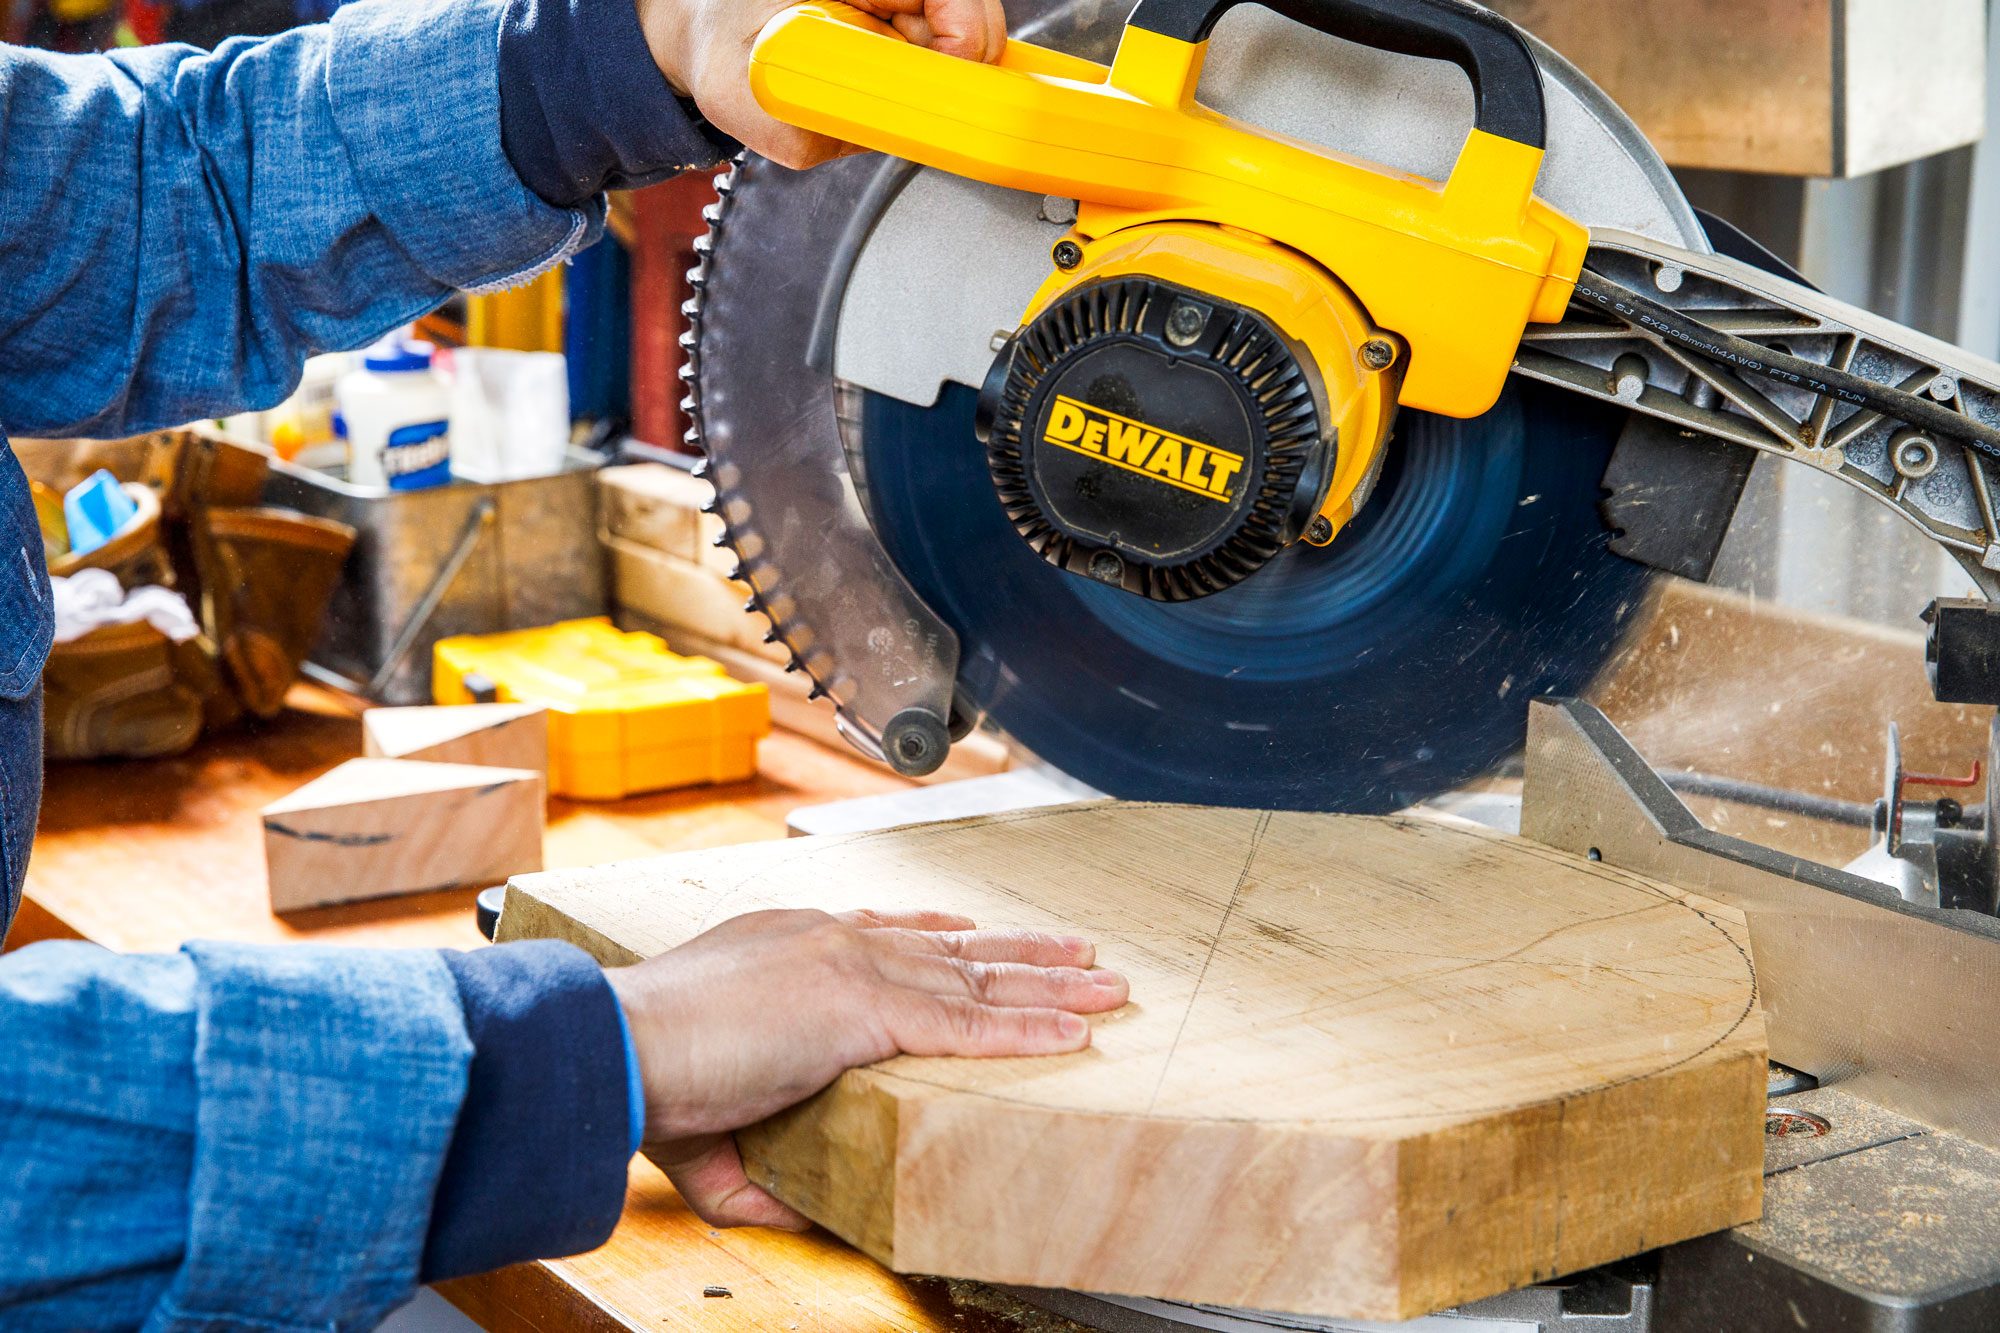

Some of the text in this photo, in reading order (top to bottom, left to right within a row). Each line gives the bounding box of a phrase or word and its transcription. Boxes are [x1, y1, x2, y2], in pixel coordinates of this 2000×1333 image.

[1615, 303, 1635, 315] SJ
[1769, 368, 1801, 382] FT2
[1809, 380, 1828, 392] TA
[1837, 388, 1867, 403] TUN
